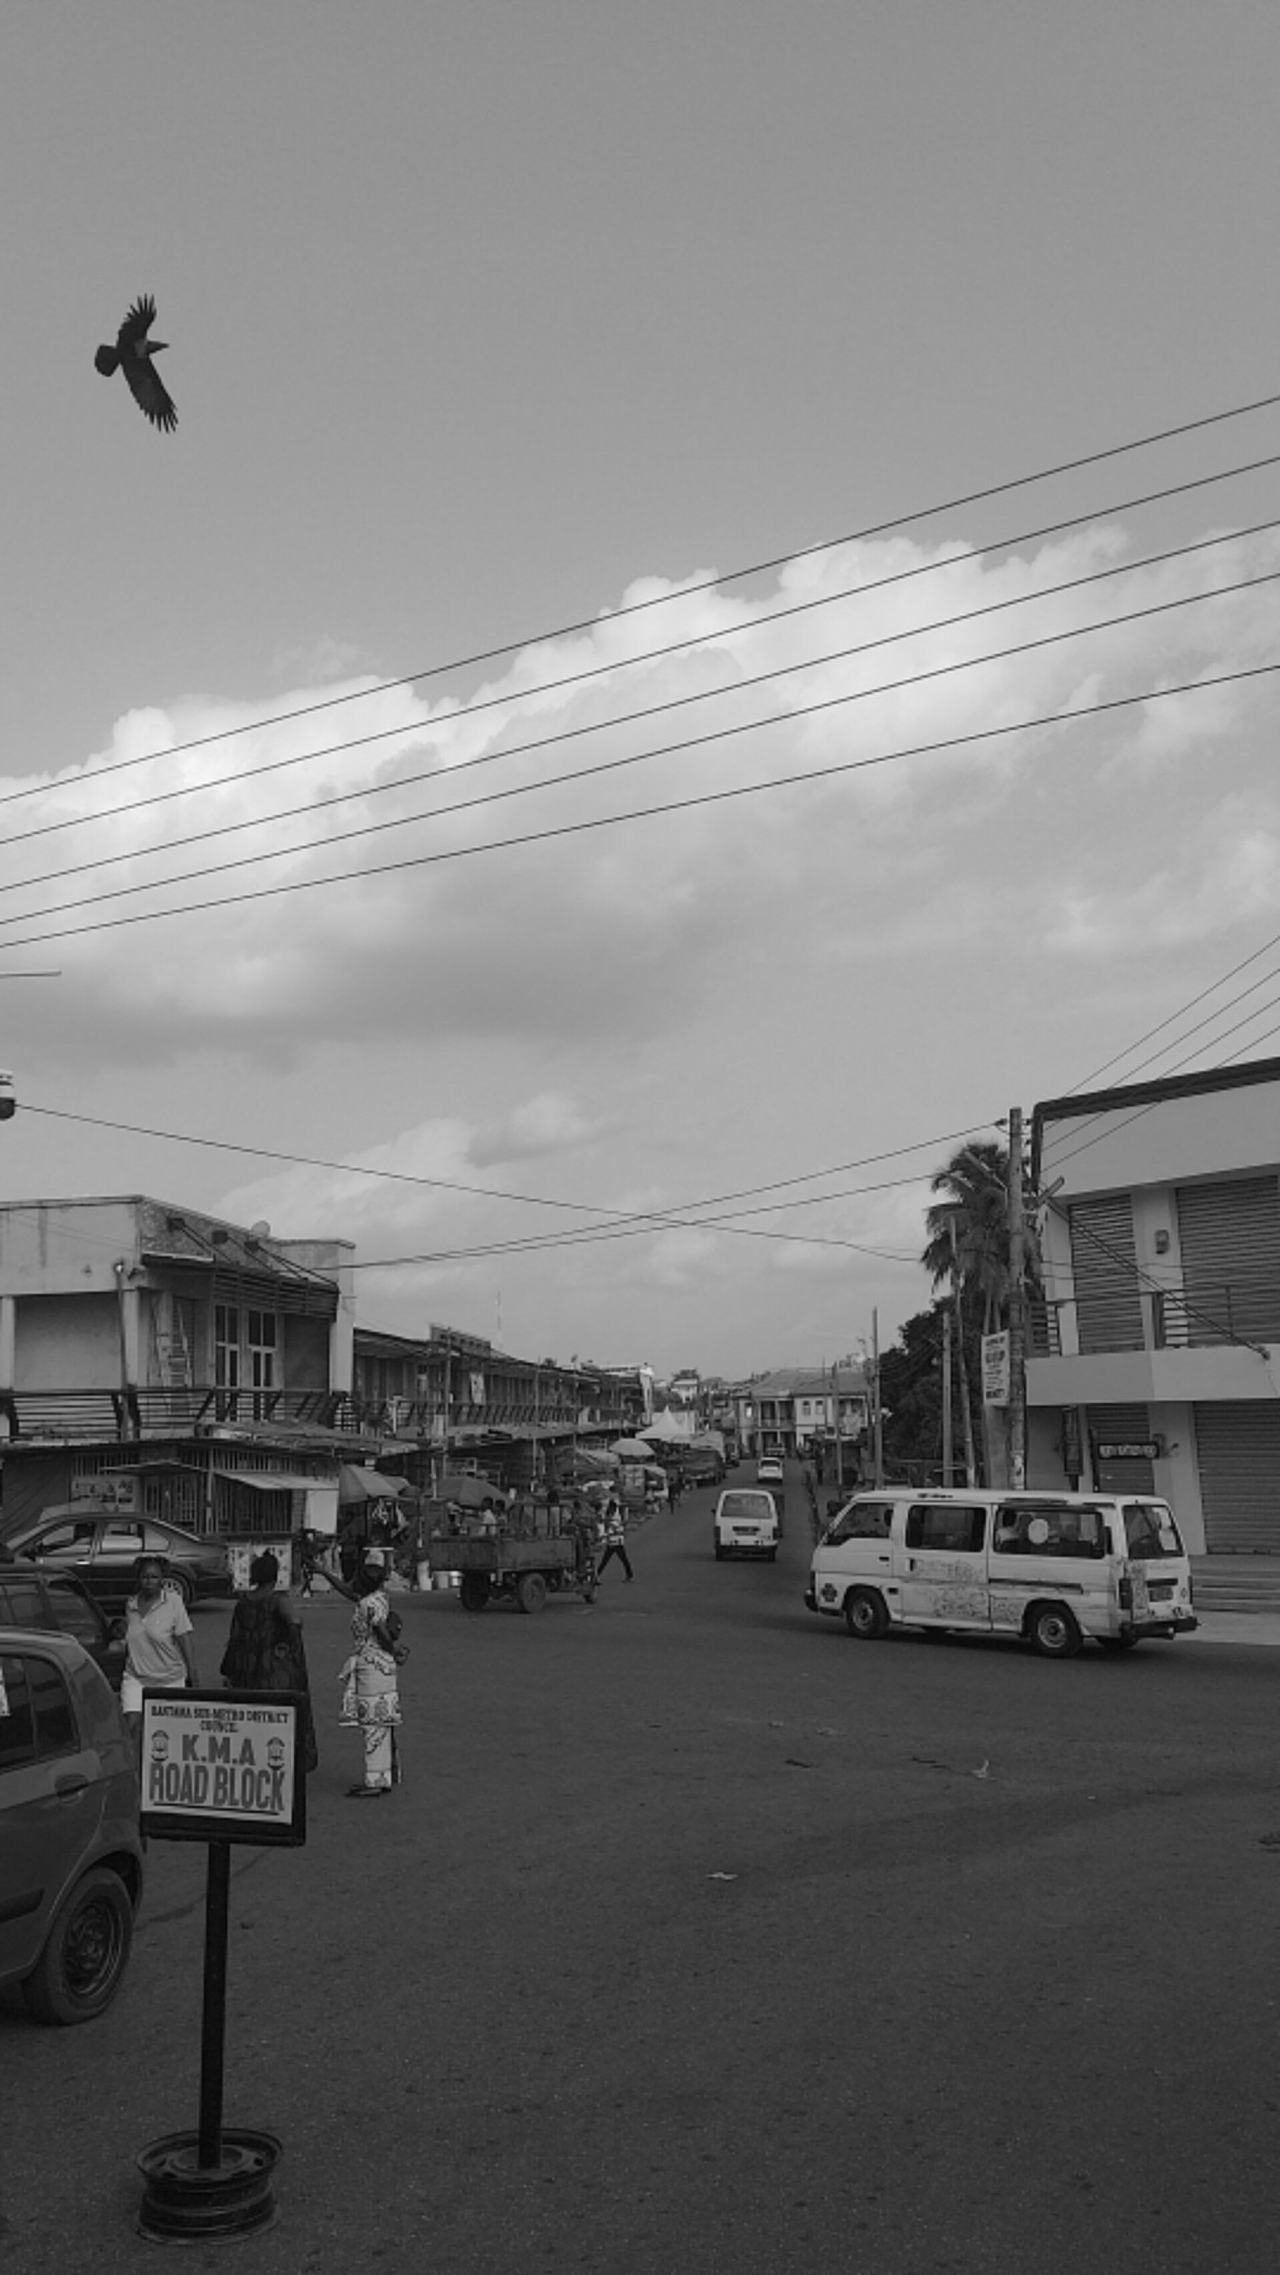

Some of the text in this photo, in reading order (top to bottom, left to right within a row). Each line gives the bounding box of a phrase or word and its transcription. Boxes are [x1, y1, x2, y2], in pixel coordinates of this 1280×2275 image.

[151, 1705, 192, 1718] BANTAMA
[246, 1710, 288, 1724] DISTRICT
[200, 1720, 238, 1733] COUNCIL
[182, 1734, 256, 1766] K.M.A
[149, 1762, 285, 1812] ROAD BLOCK
